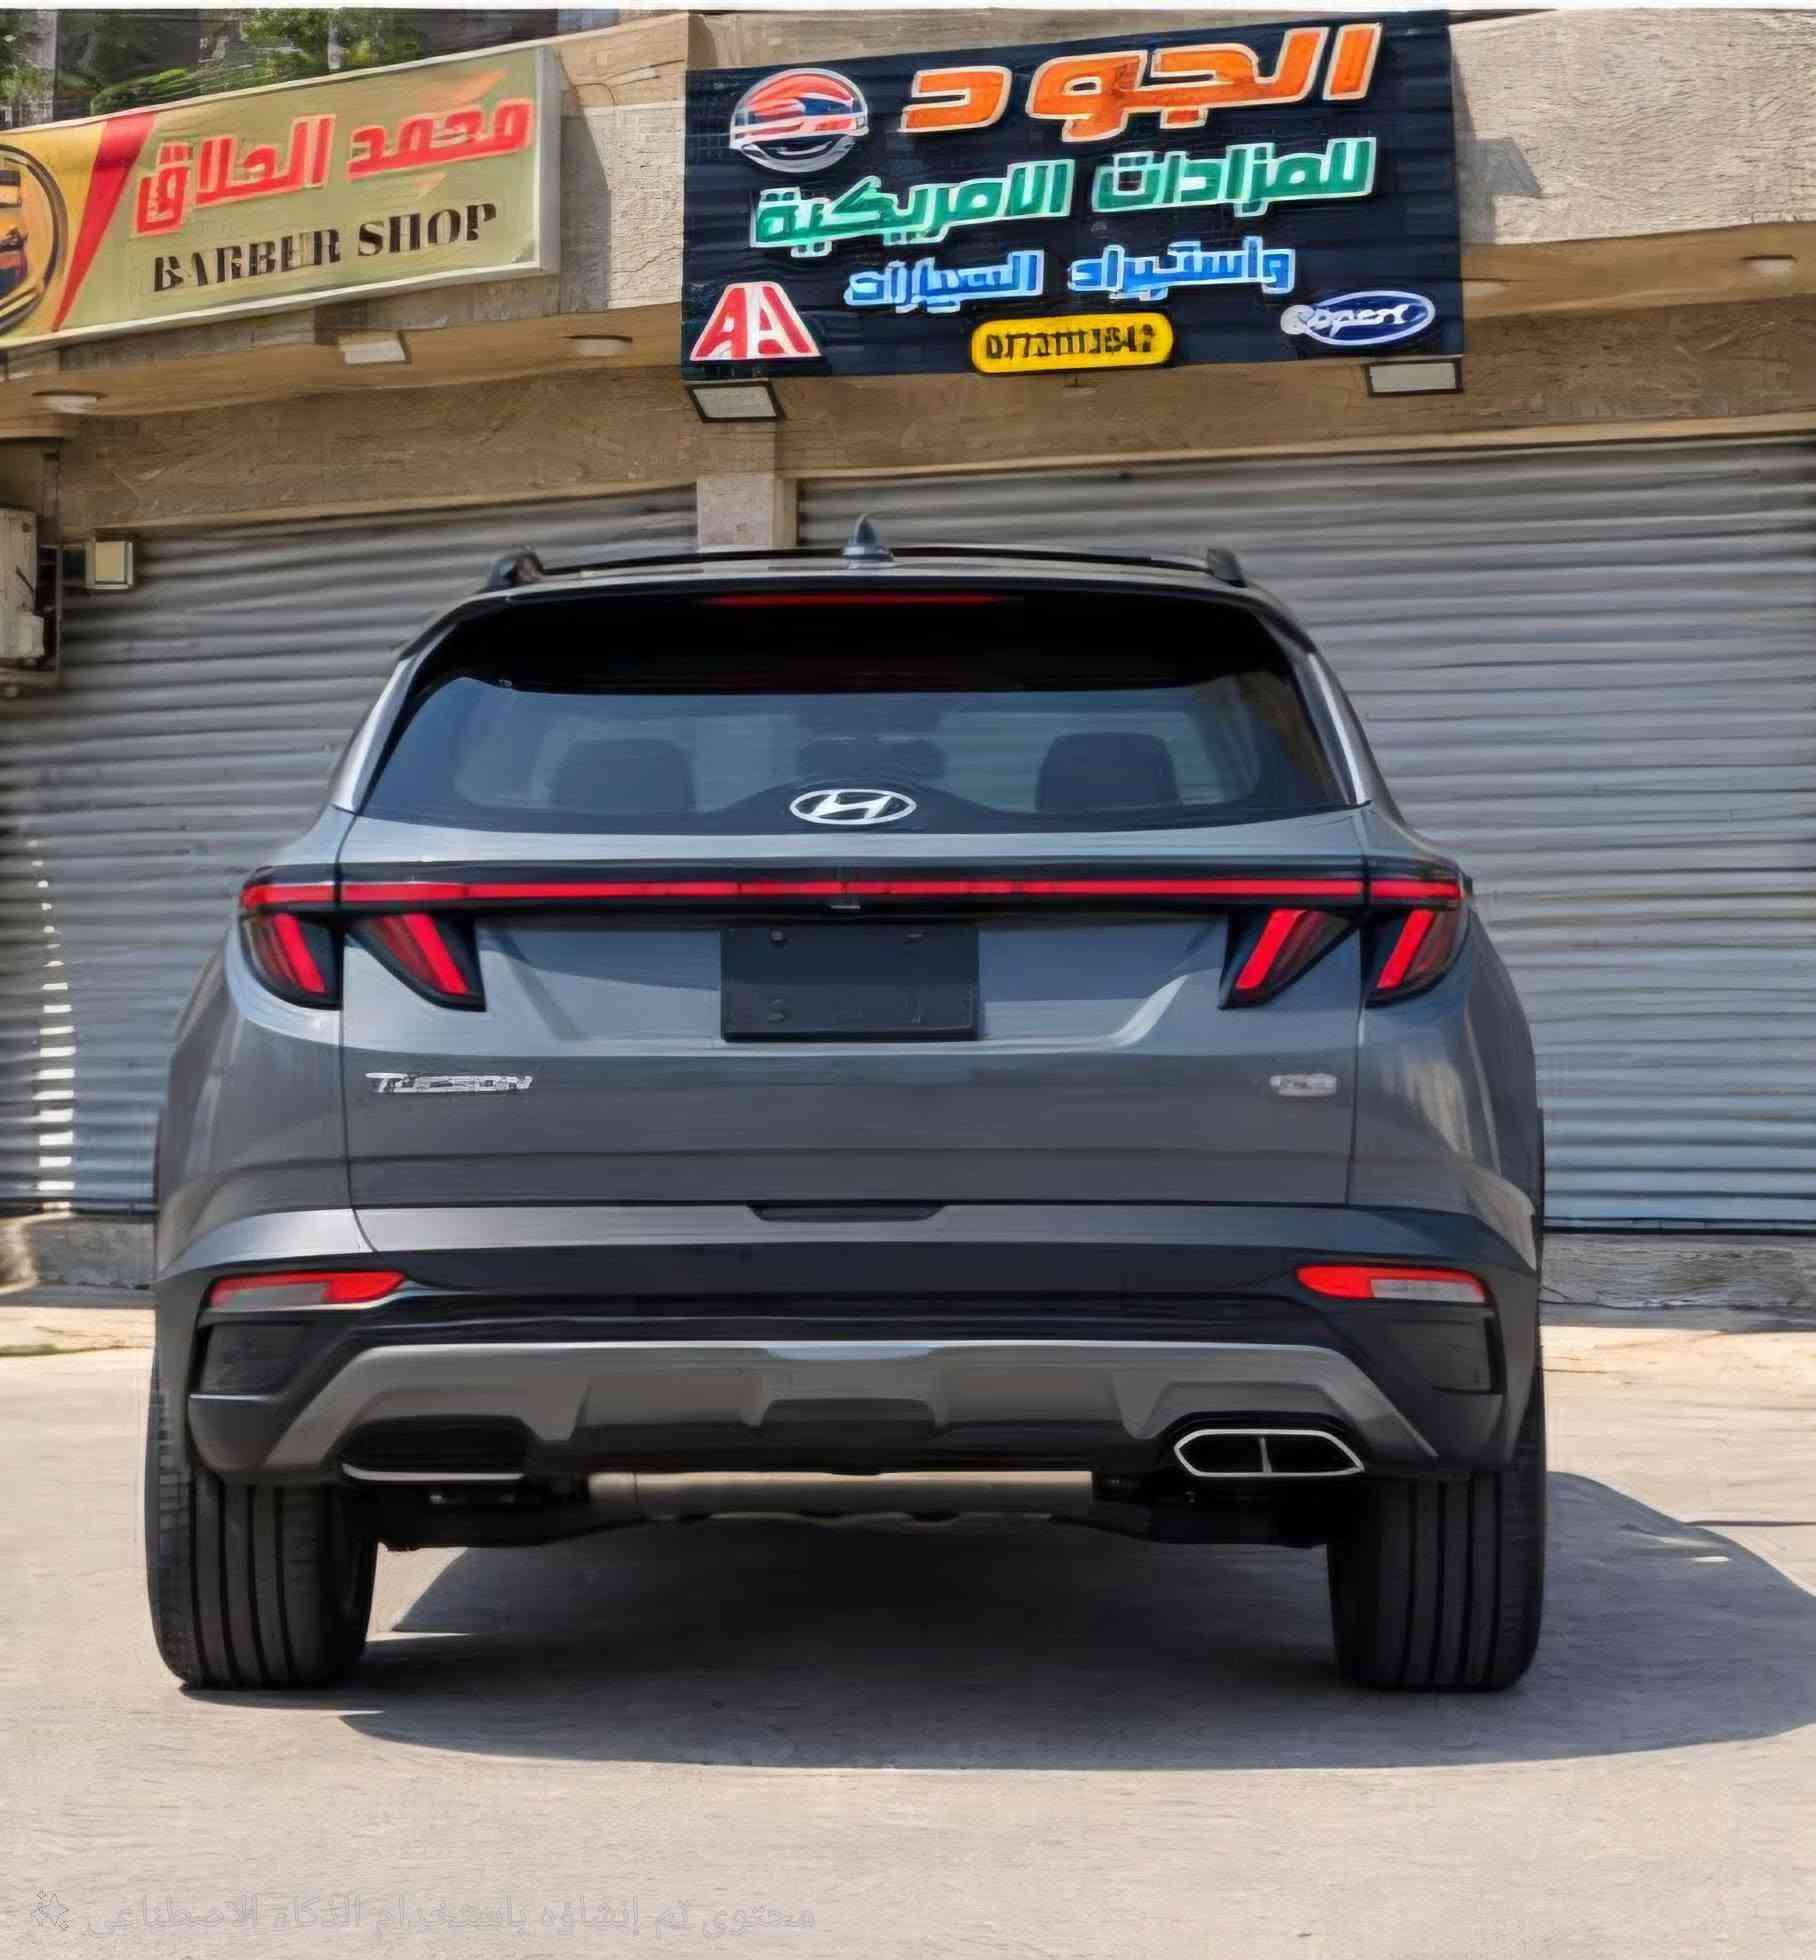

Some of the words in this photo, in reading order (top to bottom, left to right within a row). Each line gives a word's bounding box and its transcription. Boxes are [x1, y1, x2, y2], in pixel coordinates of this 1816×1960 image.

[898, 22, 1382, 142] الجود
[134, 113, 336, 238] الحلاق
[345, 98, 534, 182] محمد
[1092, 137, 1376, 217] للمزادات
[358, 203, 497, 256] SHOP
